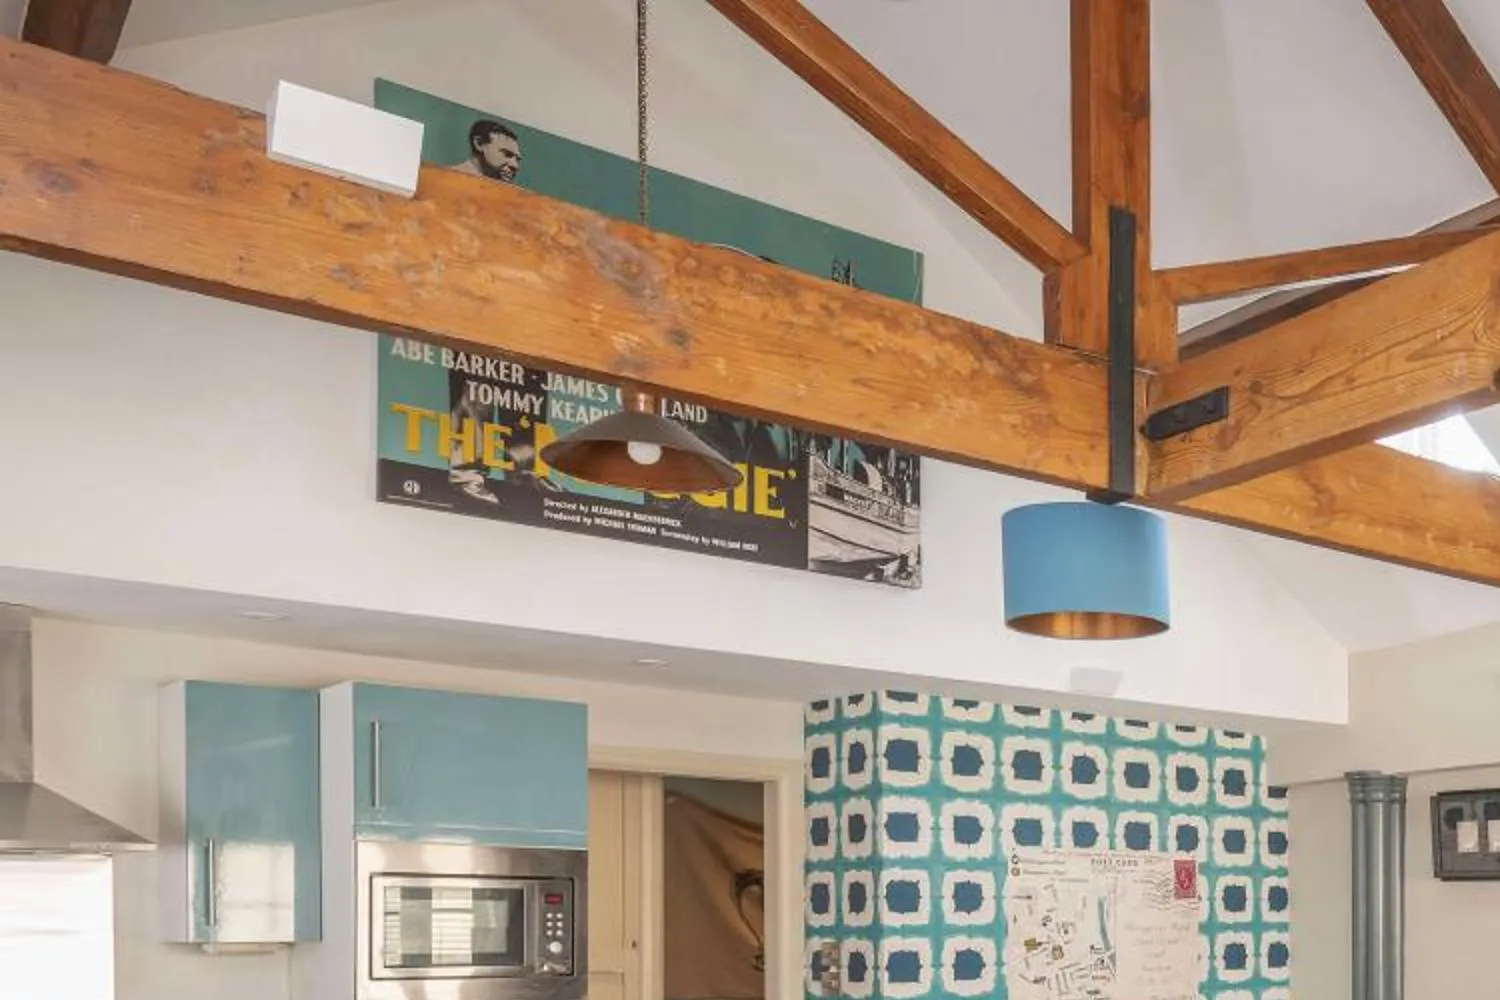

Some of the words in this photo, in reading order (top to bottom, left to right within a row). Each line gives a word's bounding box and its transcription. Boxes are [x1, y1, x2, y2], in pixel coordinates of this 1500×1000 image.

[391, 337, 436, 365] ABE
[441, 347, 525, 386] BARKER
[540, 371, 609, 403] JAMES
[466, 379, 545, 416] TOMMY
[389, 402, 515, 472] THE
